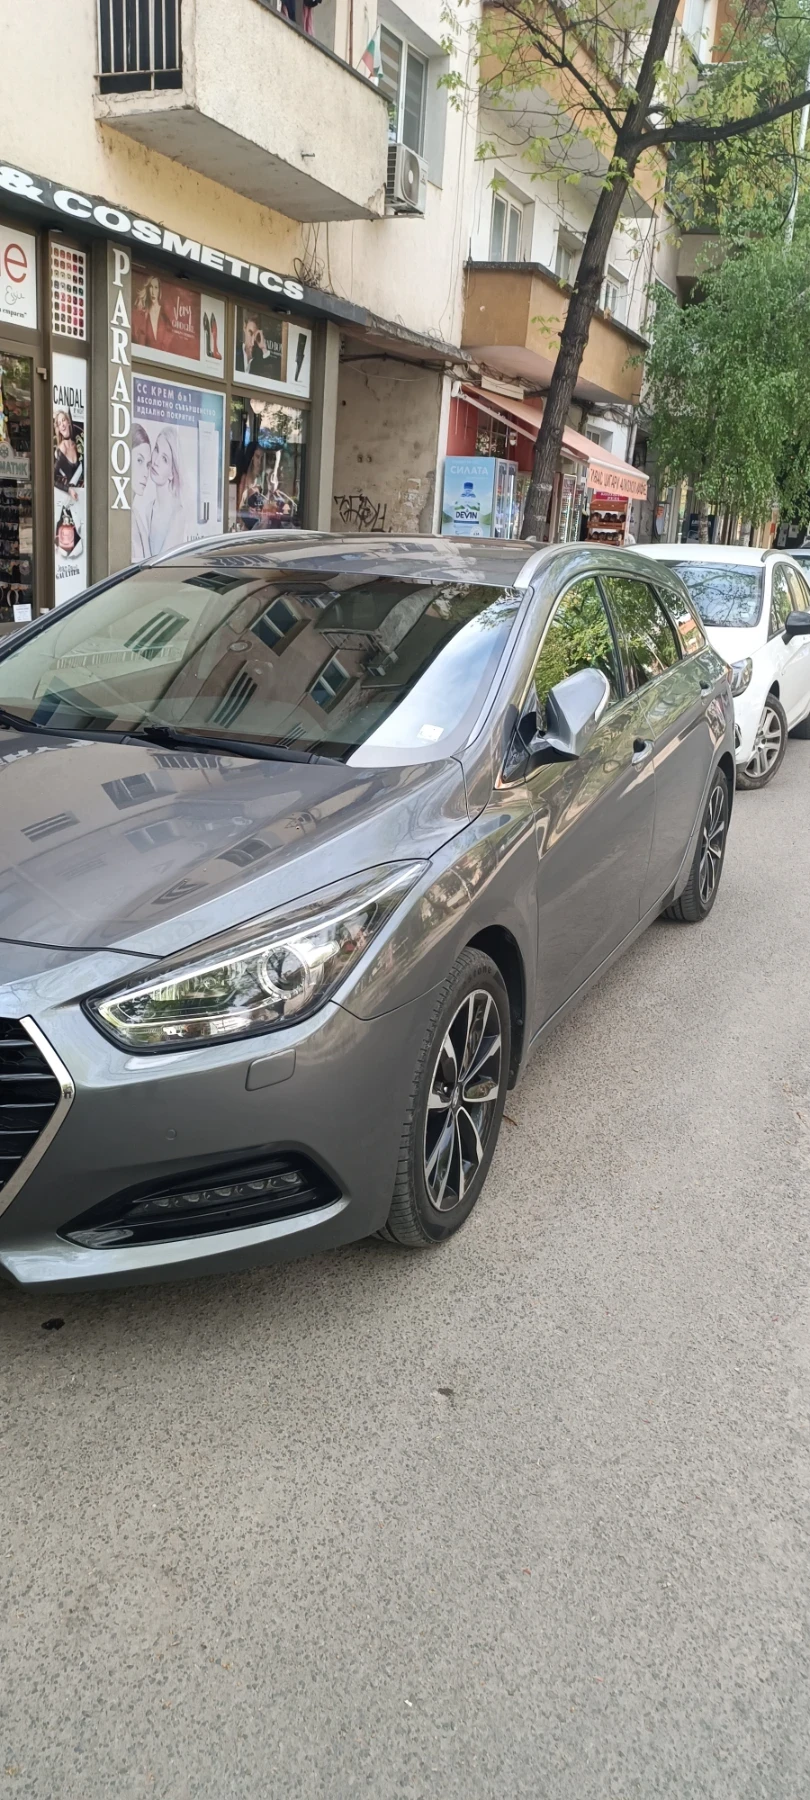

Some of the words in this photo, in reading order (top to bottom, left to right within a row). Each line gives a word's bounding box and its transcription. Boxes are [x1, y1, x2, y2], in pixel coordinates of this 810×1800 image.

[0, 166, 45, 204] &
[53, 190, 304, 300] COSMETICS
[110, 249, 131, 510] PARADOX
[151, 386, 175, 400] КРЕМ
[136, 396, 174, 409] АБСОЛЮТНО
[136, 406, 165, 417] ИДЕАЛНО
[450, 465, 488, 476] СИЛАТА
[456, 511, 477, 519] DEVIN
